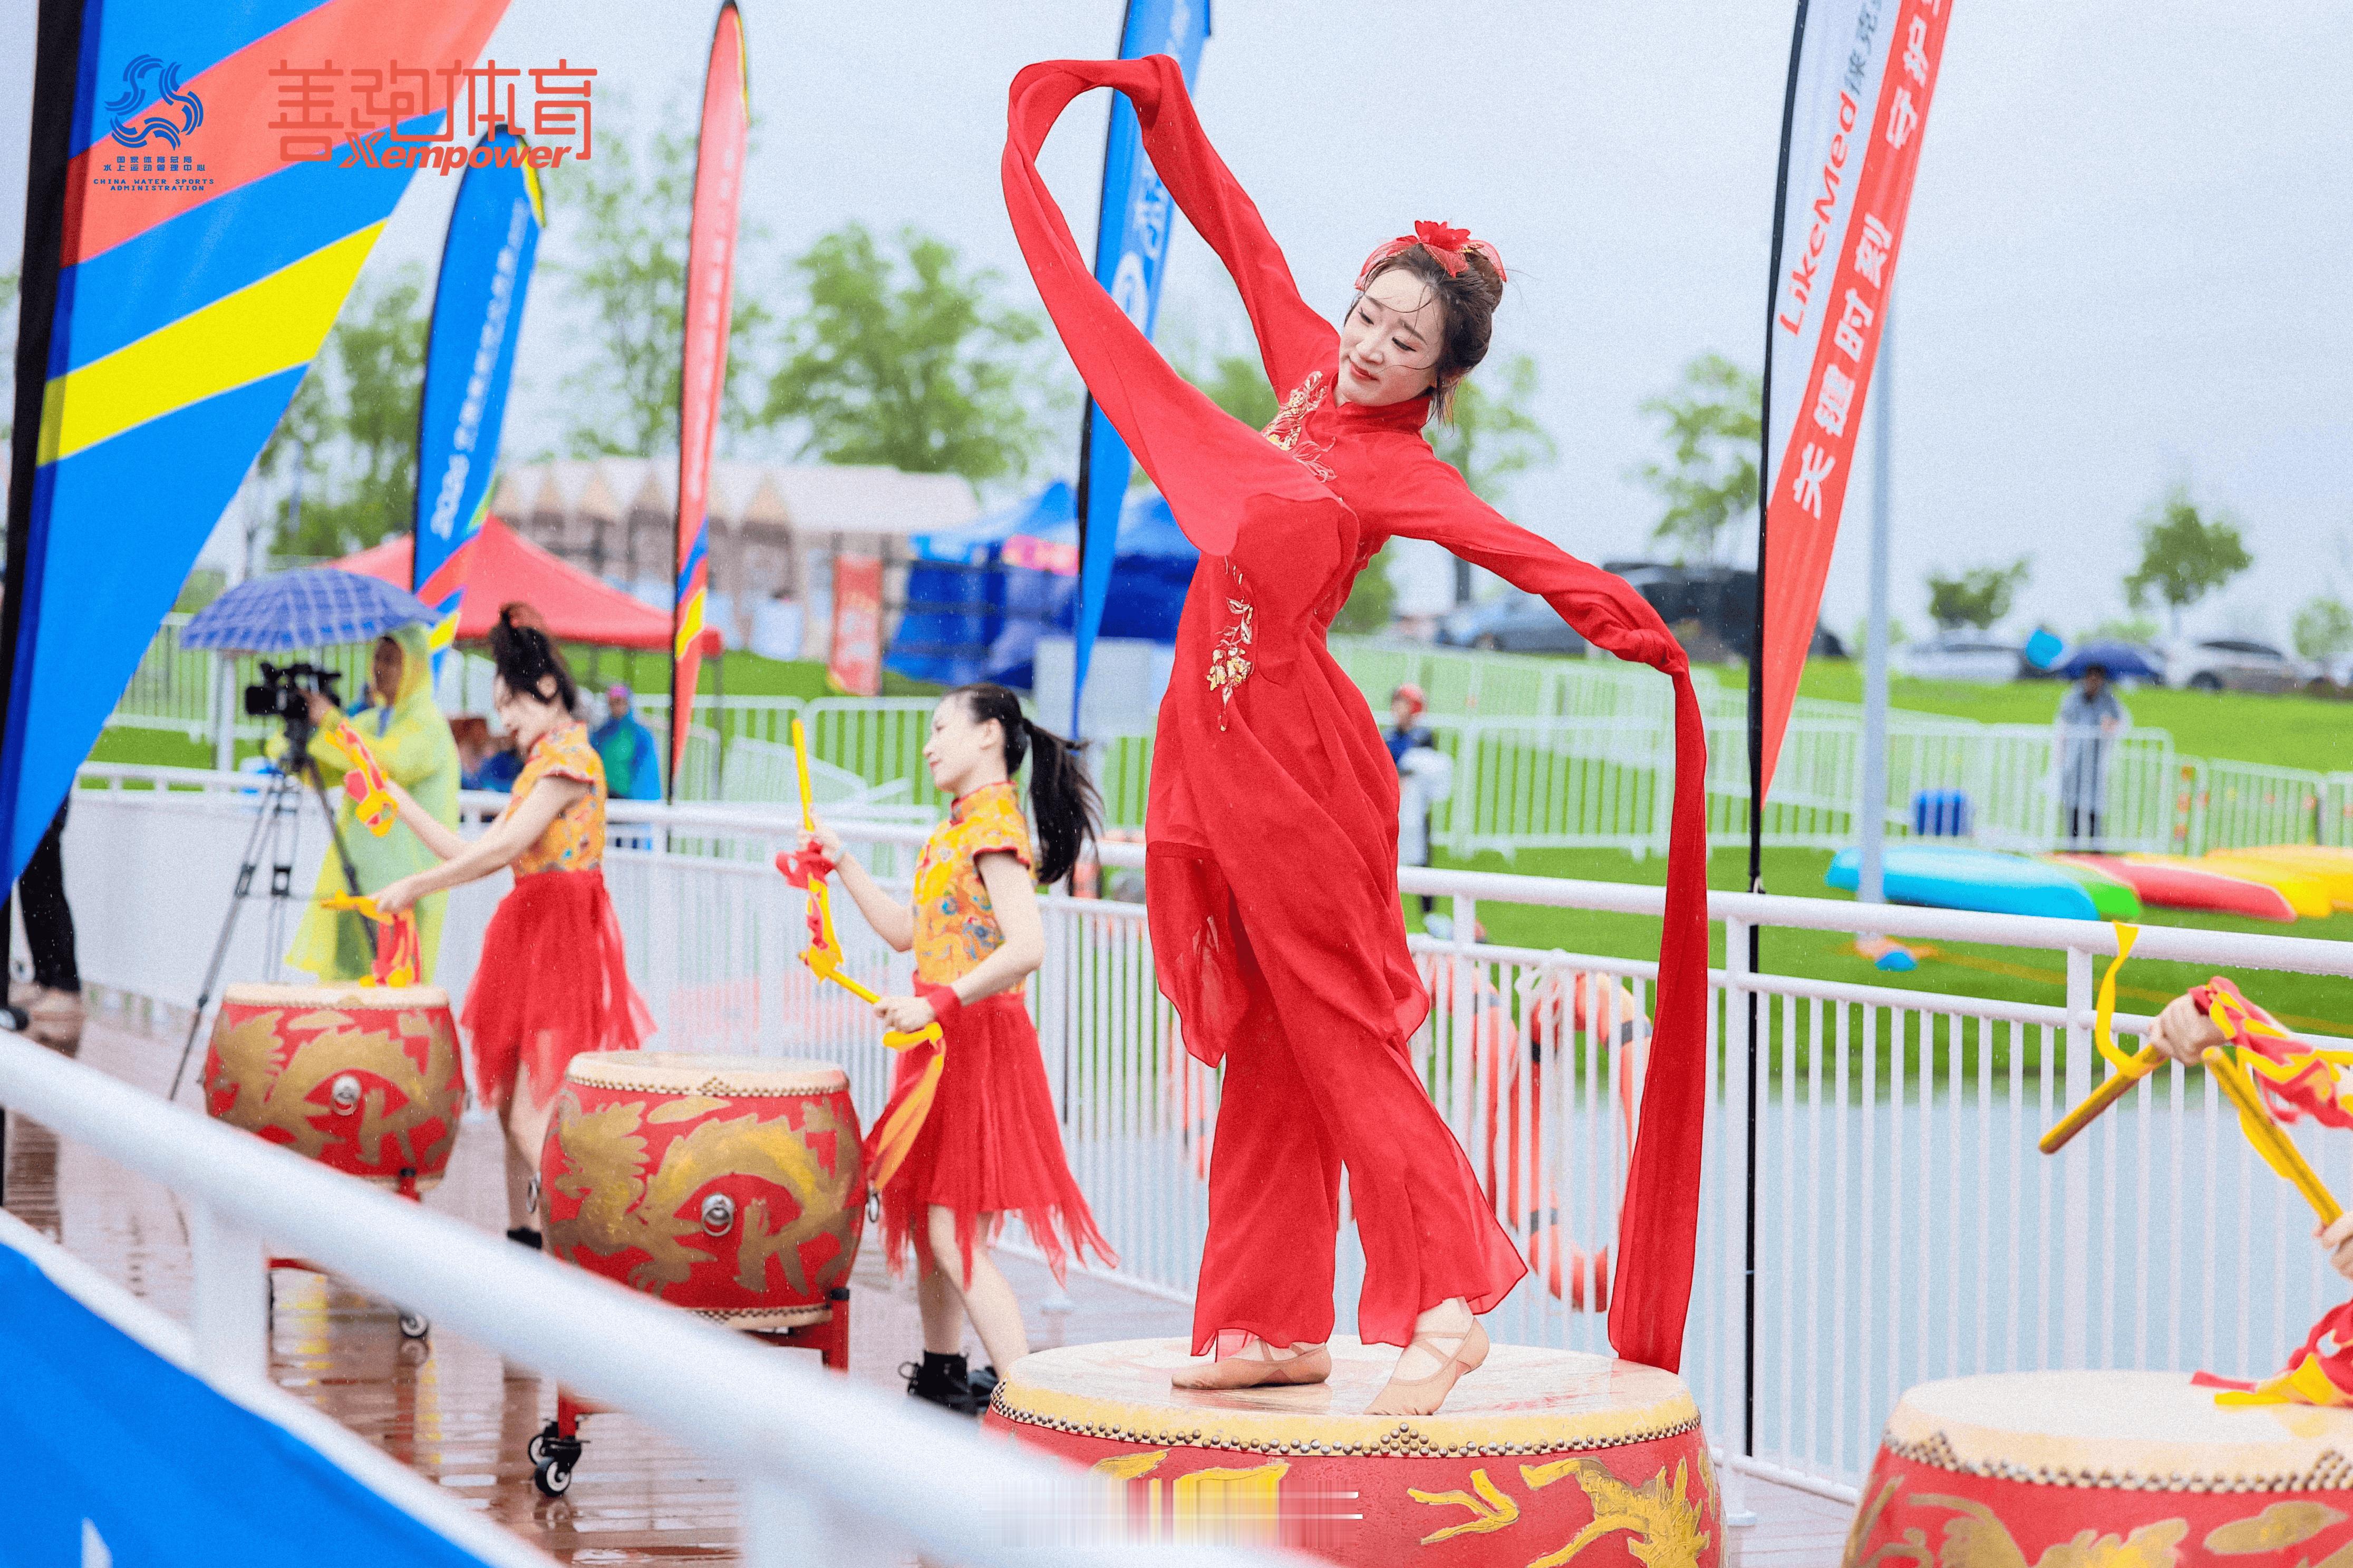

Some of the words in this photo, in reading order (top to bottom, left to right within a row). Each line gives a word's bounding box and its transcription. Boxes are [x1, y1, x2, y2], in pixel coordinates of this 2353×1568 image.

[1779, 91, 1858, 336] LikeMed
[1794, 214, 1892, 520] 关键时刻
